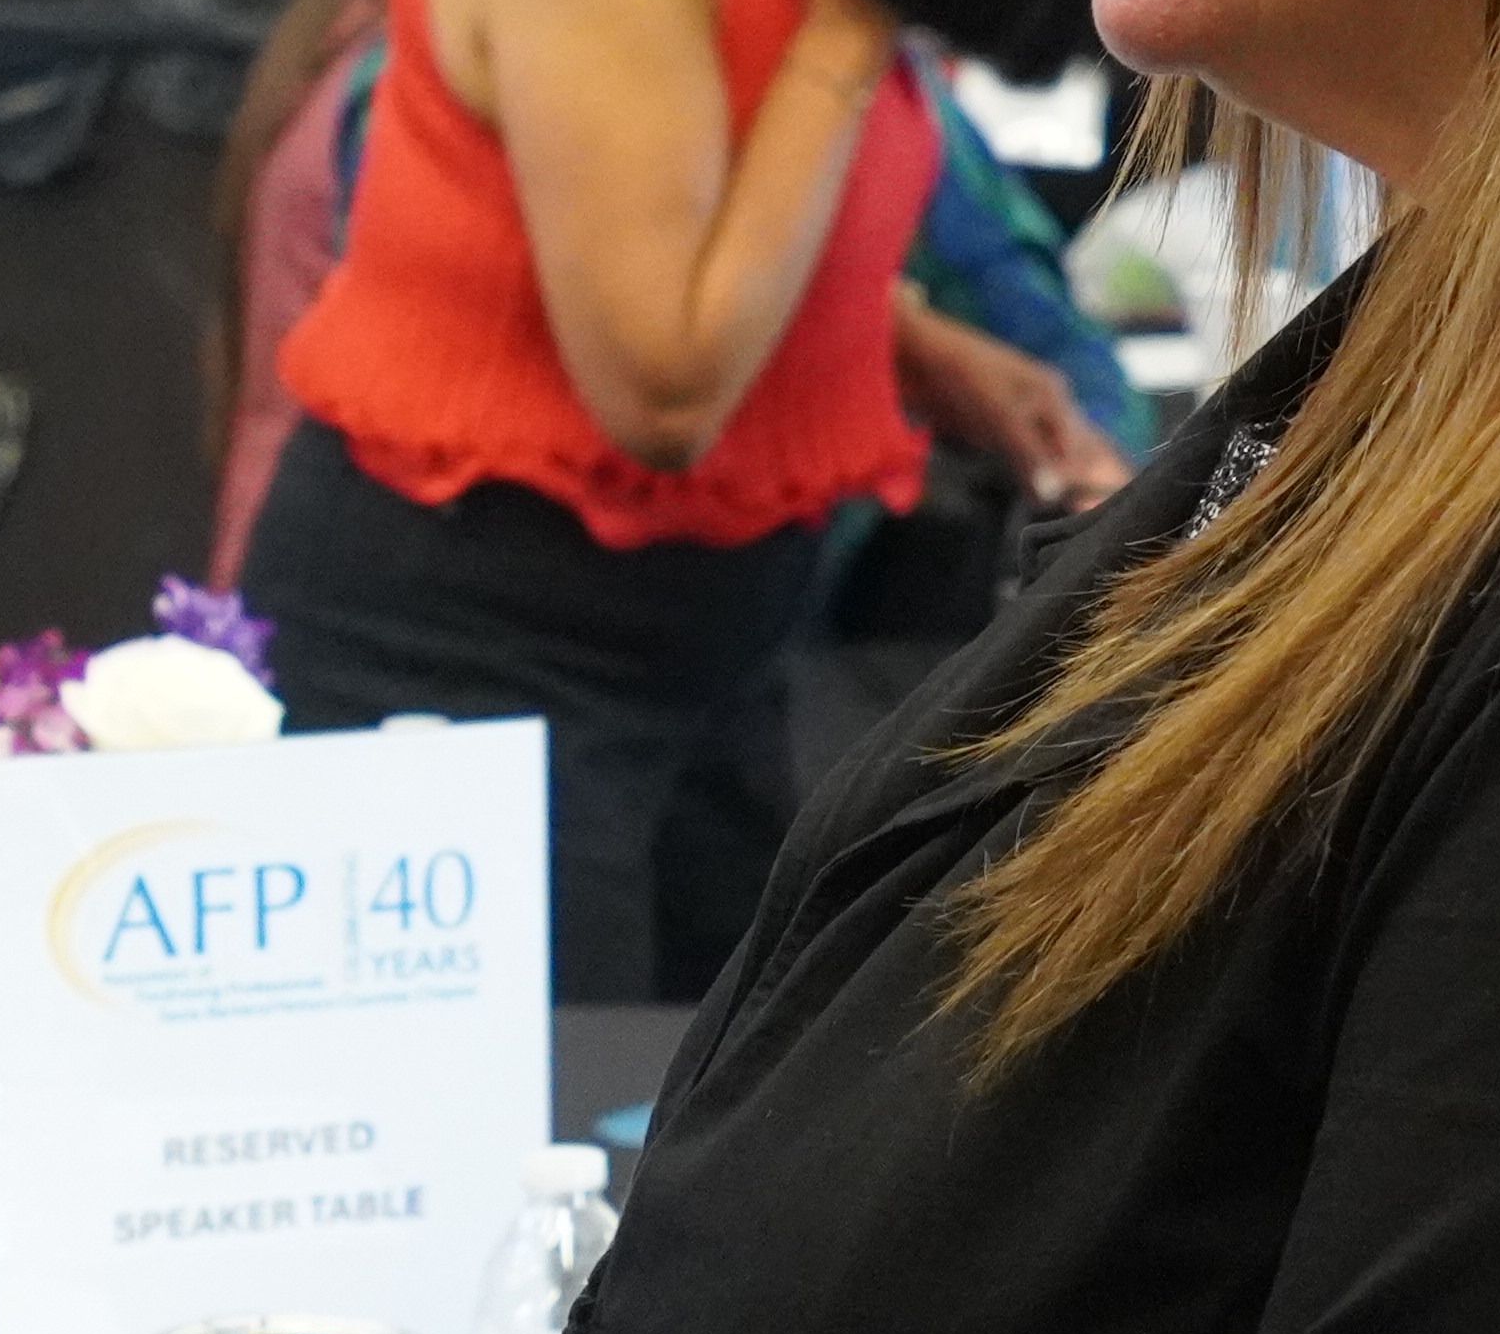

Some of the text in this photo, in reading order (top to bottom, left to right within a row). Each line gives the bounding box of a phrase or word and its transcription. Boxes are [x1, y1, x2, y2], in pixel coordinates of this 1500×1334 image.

[103, 862, 307, 964] AFP
[370, 850, 476, 932] 40
[370, 944, 481, 981] YEARS
[164, 1121, 376, 1168] RESERVED
[114, 1186, 426, 1244] SPEAKER TABLE
